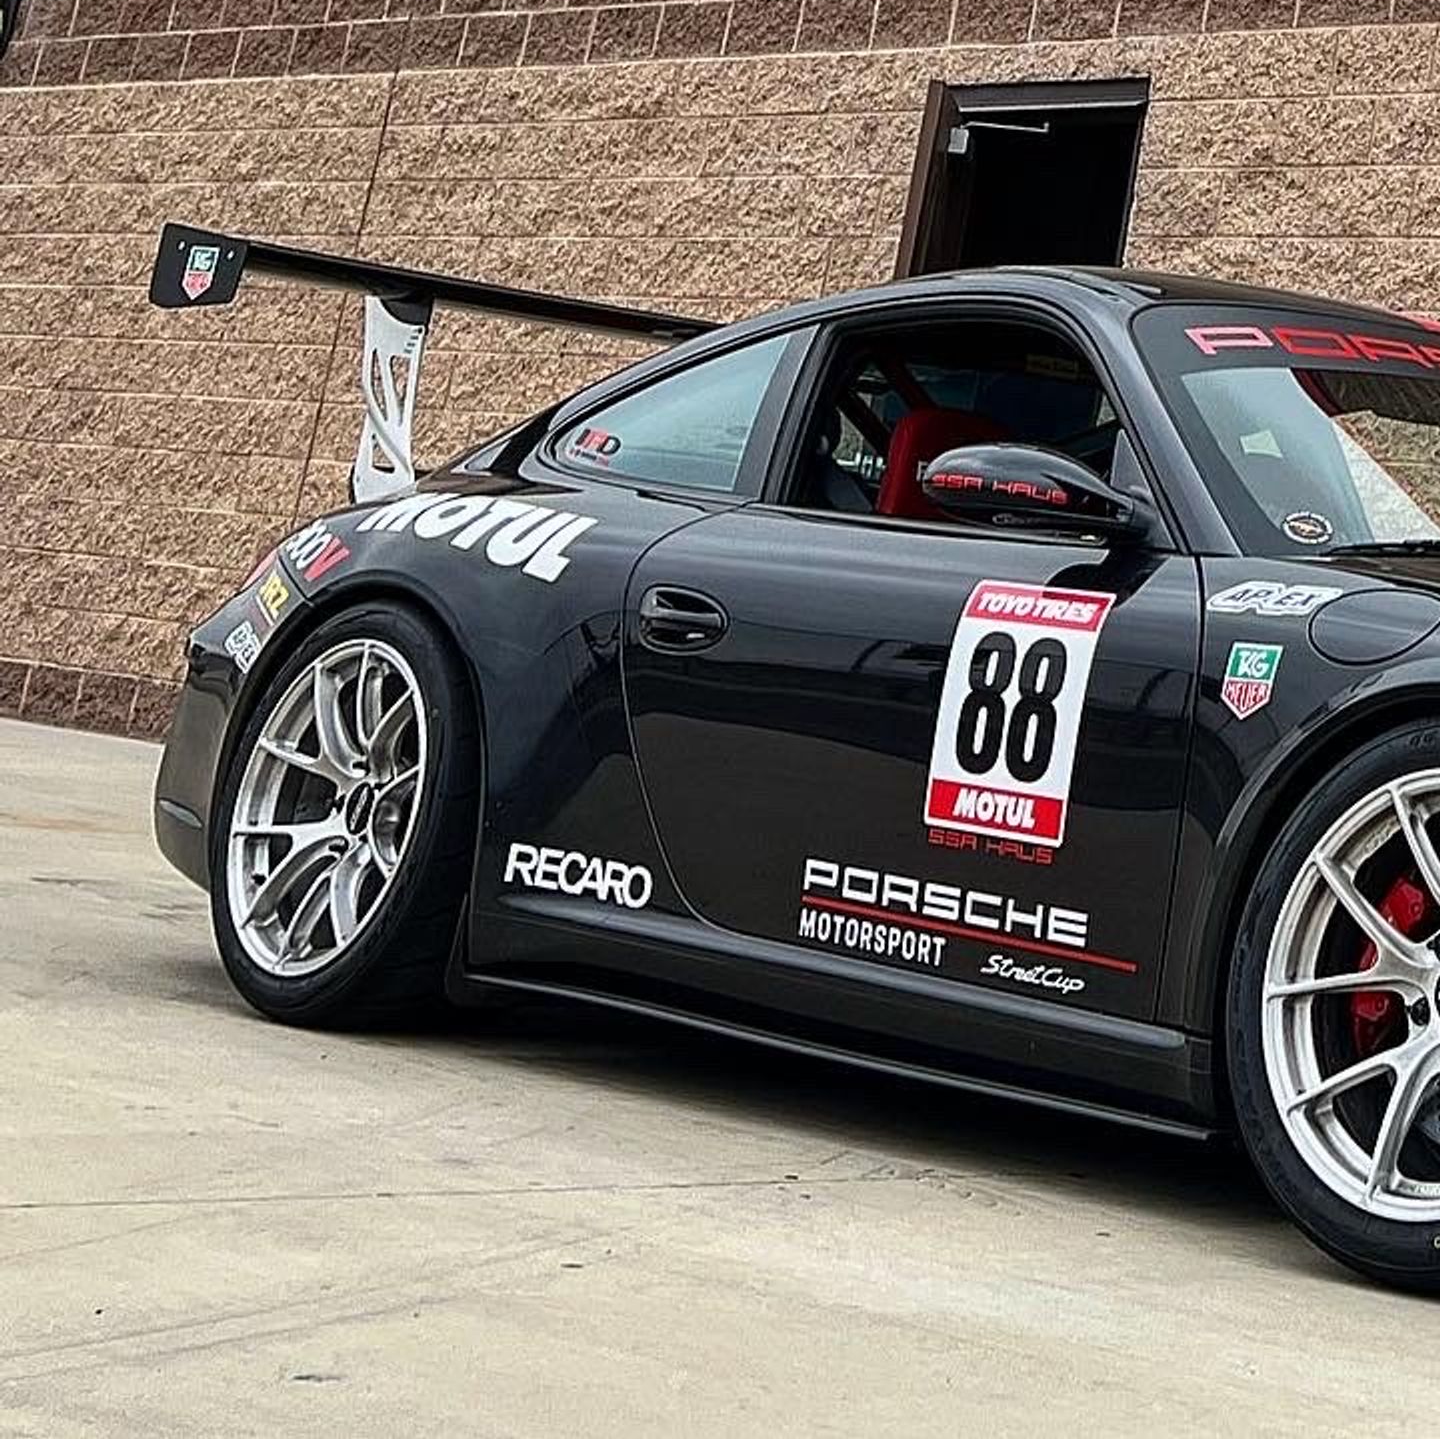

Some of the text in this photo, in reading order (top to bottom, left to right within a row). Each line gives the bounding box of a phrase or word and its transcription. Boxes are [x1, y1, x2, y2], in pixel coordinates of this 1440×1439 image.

[991, 479, 1068, 505] HAUS
[355, 492, 599, 583] MOTUL
[1236, 649, 1270, 678] TAG
[955, 631, 1067, 784] 88
[1225, 681, 1267, 712] HEUER
[952, 787, 1036, 829] MOTUL
[928, 828, 1054, 865] SSA HAUS
[504, 842, 653, 910] RECARO
[803, 858, 1089, 948] PORSCHE
[798, 908, 947, 967] MOTORSPORT
